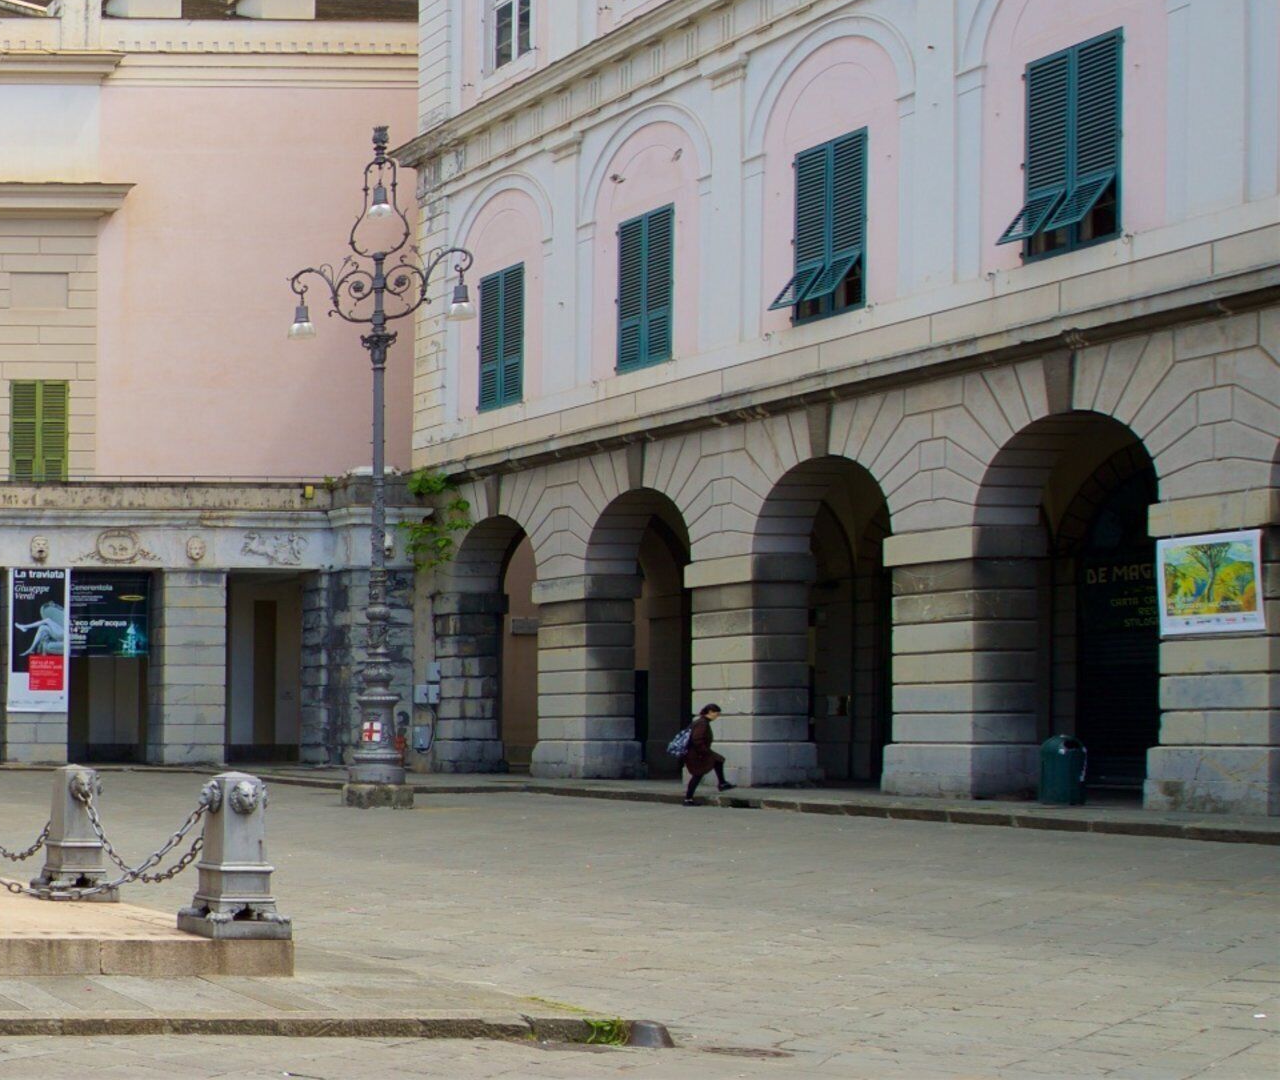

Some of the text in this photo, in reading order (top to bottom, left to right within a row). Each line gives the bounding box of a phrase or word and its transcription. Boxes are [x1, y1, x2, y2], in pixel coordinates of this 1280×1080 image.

[14, 569, 65, 579] La traviata
[1086, 568, 1108, 584] DE
[14, 583, 51, 595] Giuseppe
[14, 592, 36, 601] Verdi
